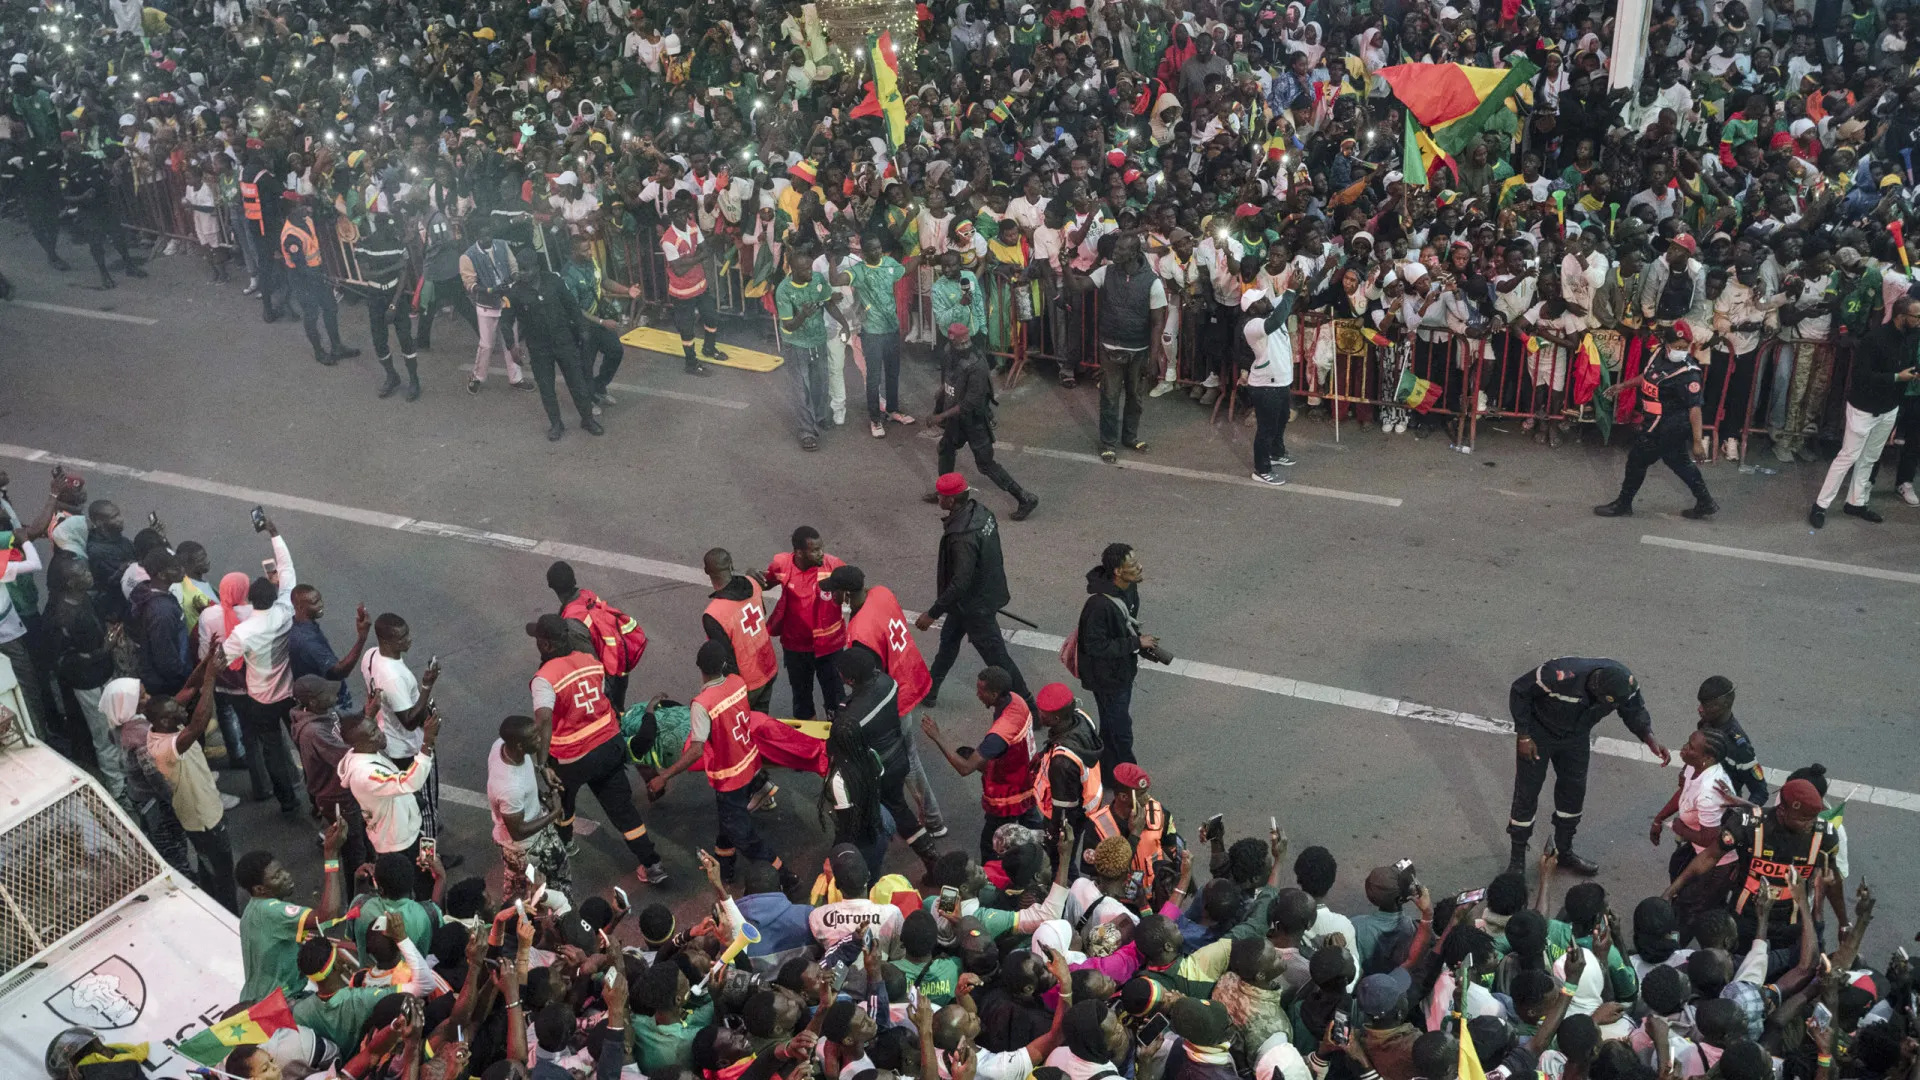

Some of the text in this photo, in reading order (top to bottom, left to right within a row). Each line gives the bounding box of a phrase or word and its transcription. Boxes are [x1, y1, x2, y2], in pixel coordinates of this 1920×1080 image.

[1752, 859, 1812, 877] POLIE
[822, 910, 881, 929] Corona
[921, 979, 951, 996] BADARA
